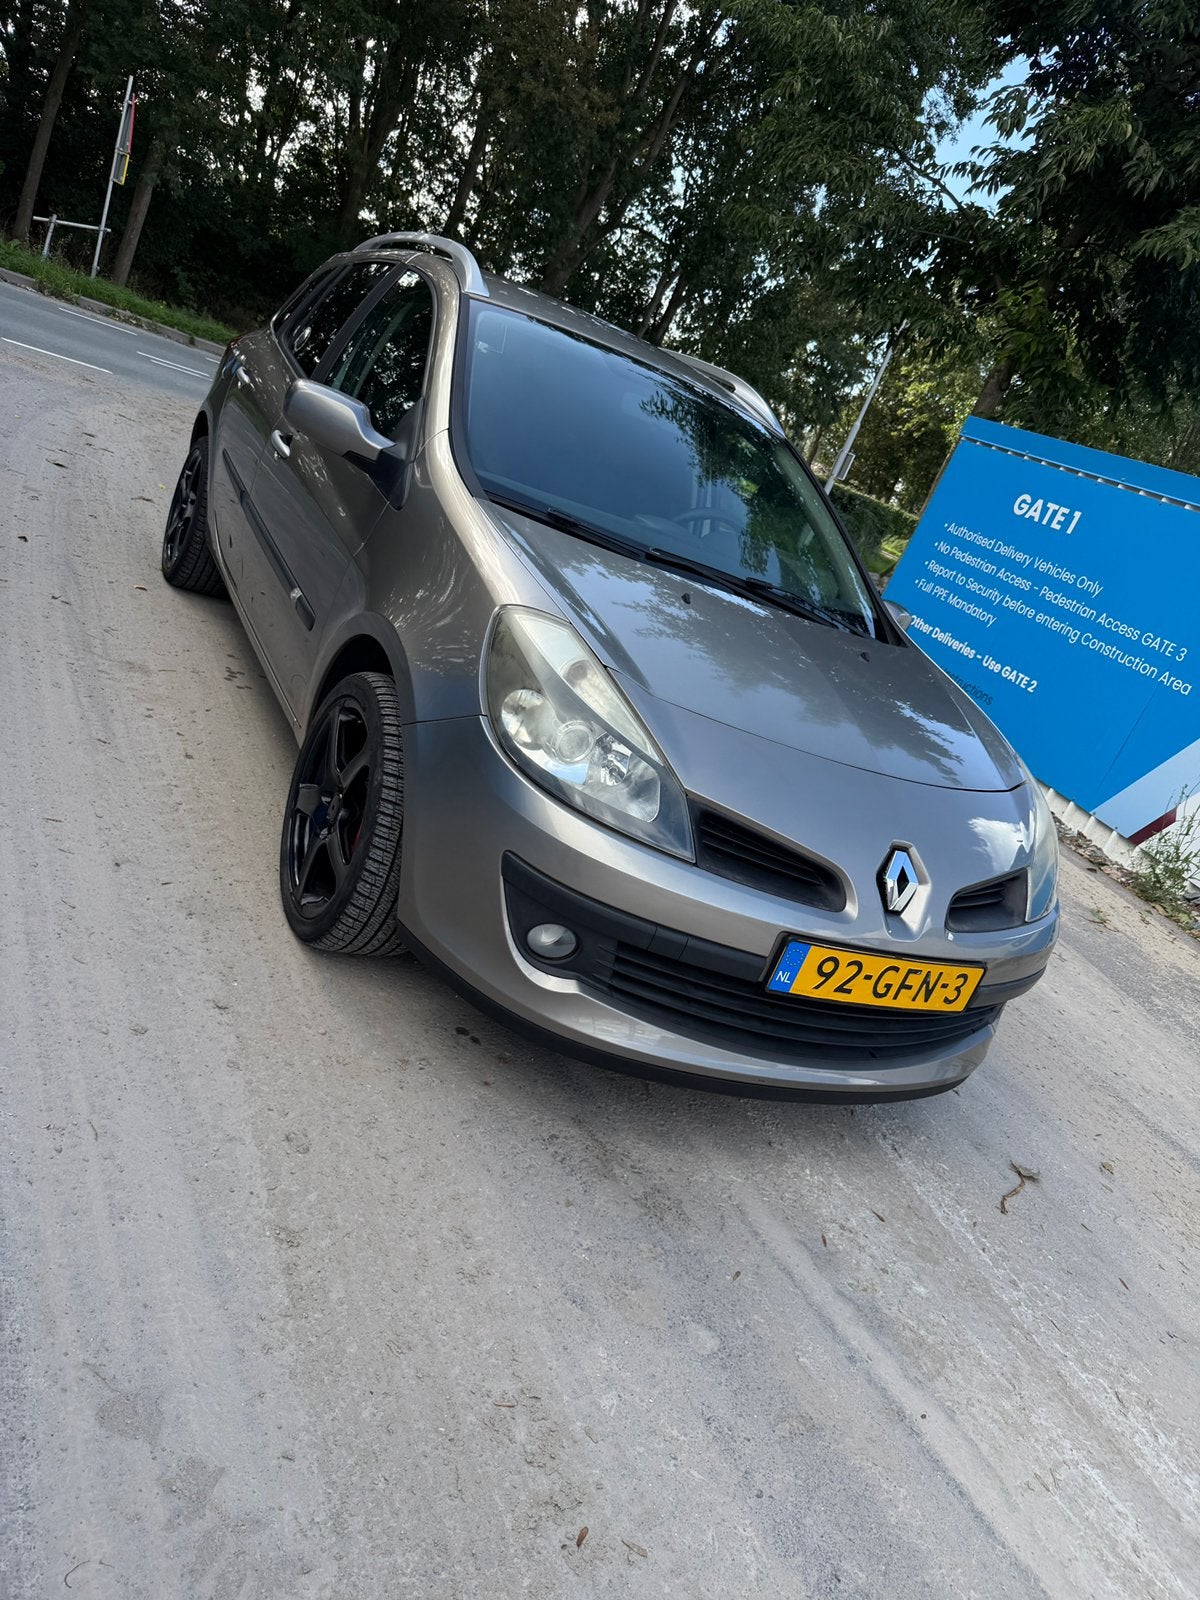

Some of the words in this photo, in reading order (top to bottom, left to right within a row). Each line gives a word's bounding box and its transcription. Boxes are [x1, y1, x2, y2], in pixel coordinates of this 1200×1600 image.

[1013, 493, 1069, 531] GATE
[1067, 510, 1082, 535] 1
[947, 522, 996, 550] Authorised
[993, 541, 1032, 569] Delivery
[1034, 557, 1077, 585] Vehicles
[1076, 575, 1104, 599] Only
[917, 578, 934, 594] Full
[932, 586, 949, 601] PPE
[947, 593, 997, 628] Mandatory
[927, 560, 958, 584] Report
[956, 573, 966, 586] to
[965, 577, 1003, 605] Security
[1002, 594, 1035, 619] before
[1035, 613, 1081, 644] entering
[1080, 632, 1158, 679] Construction
[1158, 671, 1193, 696] Area
[937, 541, 951, 555] No
[949, 546, 997, 576] Pedestrian
[997, 568, 1032, 591] Access
[1040, 586, 1097, 620] Pedestrian
[1096, 612, 1140, 640] Access
[1141, 632, 1177, 659] GATE
[1175, 647, 1188, 662] 3
[931, 627, 976, 660] Deliveries
[982, 655, 1001, 673] Use
[1001, 665, 1030, 690] GATE
[1026, 680, 1038, 693] 2
[775, 970, 791, 984] NL
[811, 956, 969, 1005] 92-GFN-3
